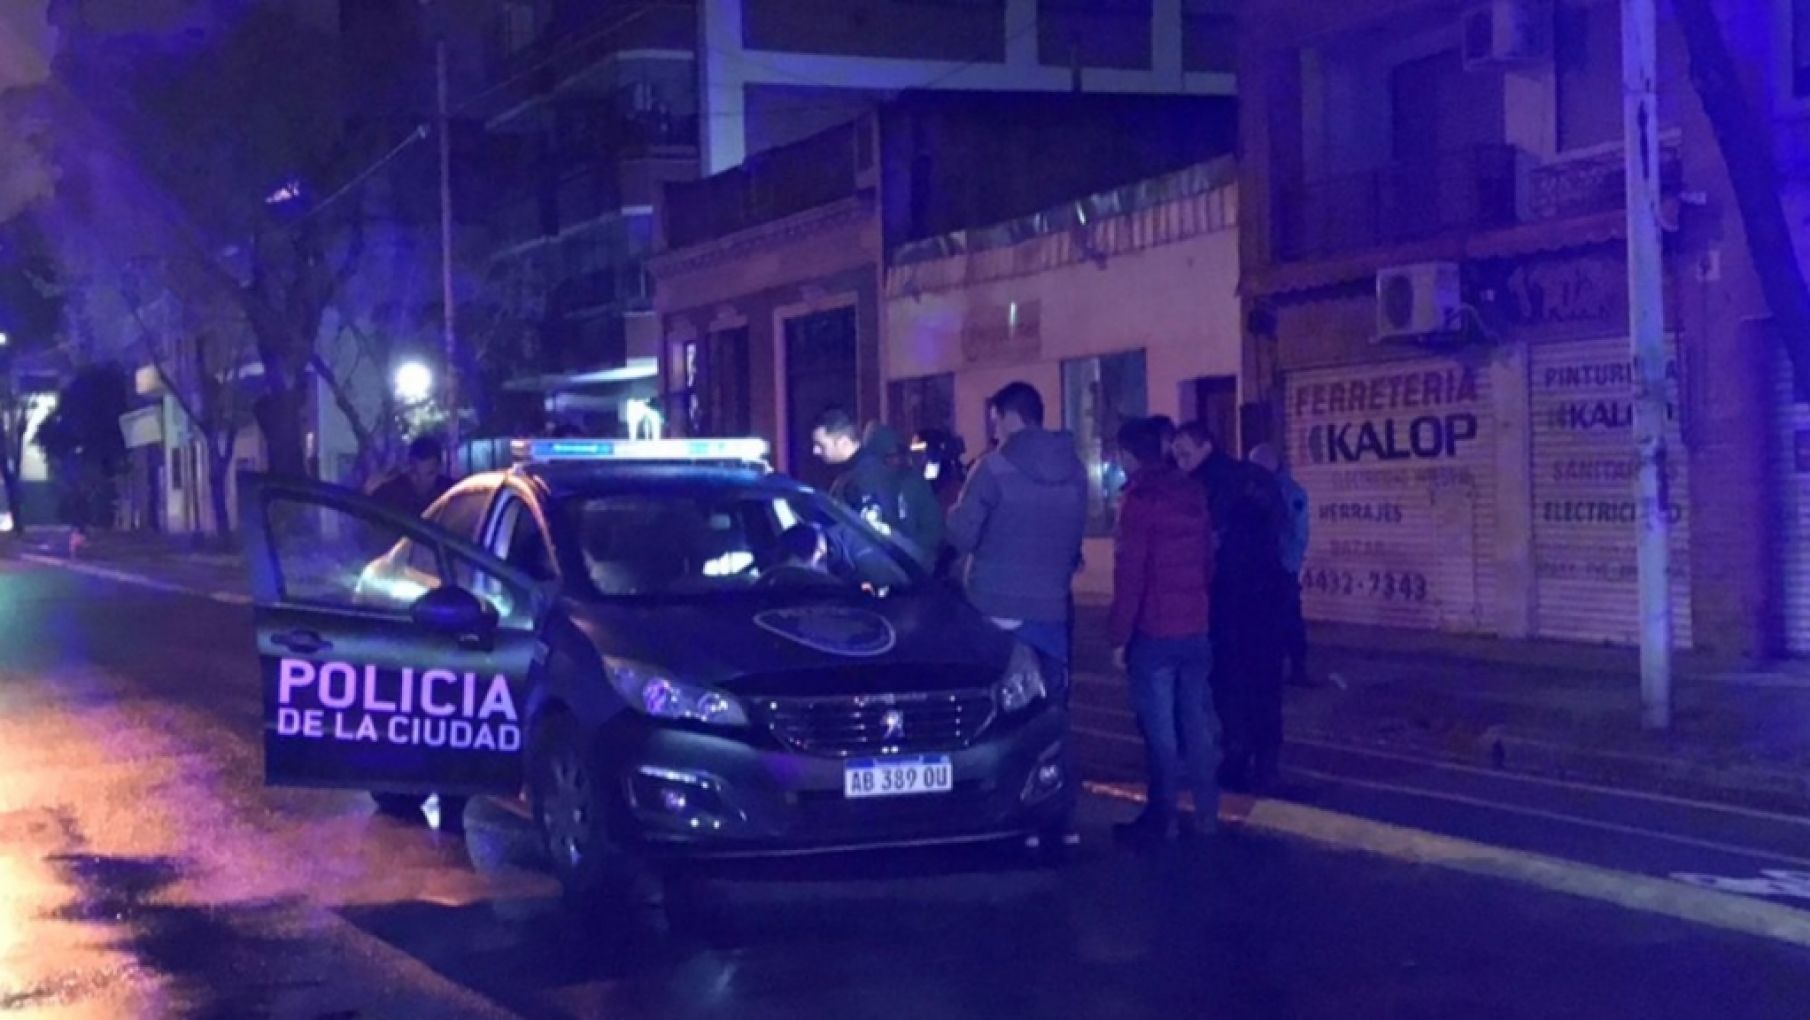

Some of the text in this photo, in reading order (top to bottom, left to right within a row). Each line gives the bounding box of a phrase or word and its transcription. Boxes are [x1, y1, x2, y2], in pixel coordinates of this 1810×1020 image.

[1295, 367, 1477, 416] FERRETERIA
[1326, 413, 1477, 463] KALOP
[1543, 501, 1682, 525] ELECTRICID
[278, 658, 518, 721] POLICIA
[277, 707, 521, 751] DE LA CIUDAD
[851, 771, 875, 793] AB
[881, 767, 918, 791] 389
